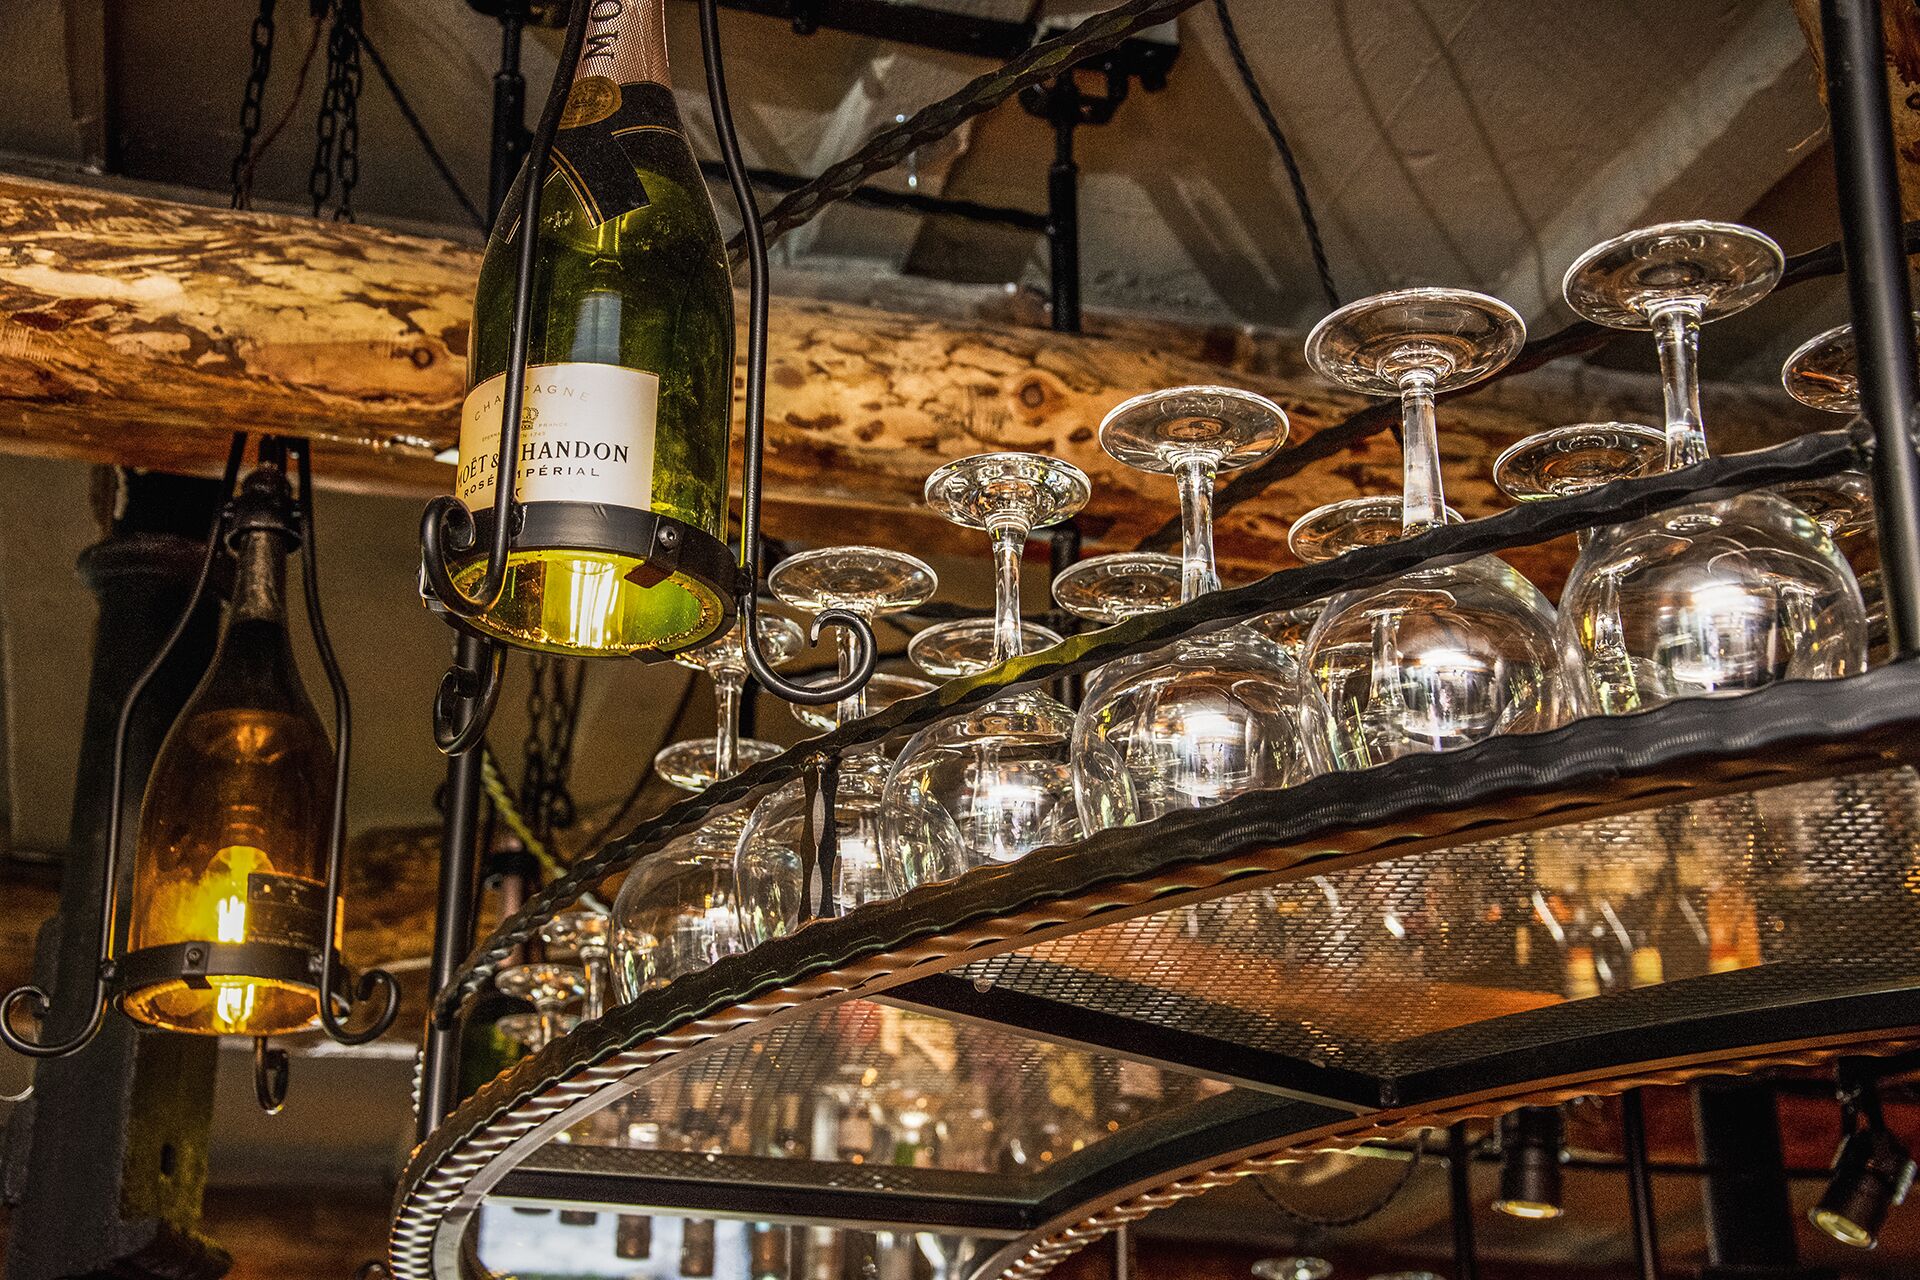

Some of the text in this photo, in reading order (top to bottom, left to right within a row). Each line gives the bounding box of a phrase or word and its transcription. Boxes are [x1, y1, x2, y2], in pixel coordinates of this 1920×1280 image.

[474, 384, 591, 421] CHAPAGNE
[490, 453, 499, 469] &
[521, 440, 629, 463] HANDON
[463, 464, 600, 499] ROSÉ PÉRIAL
